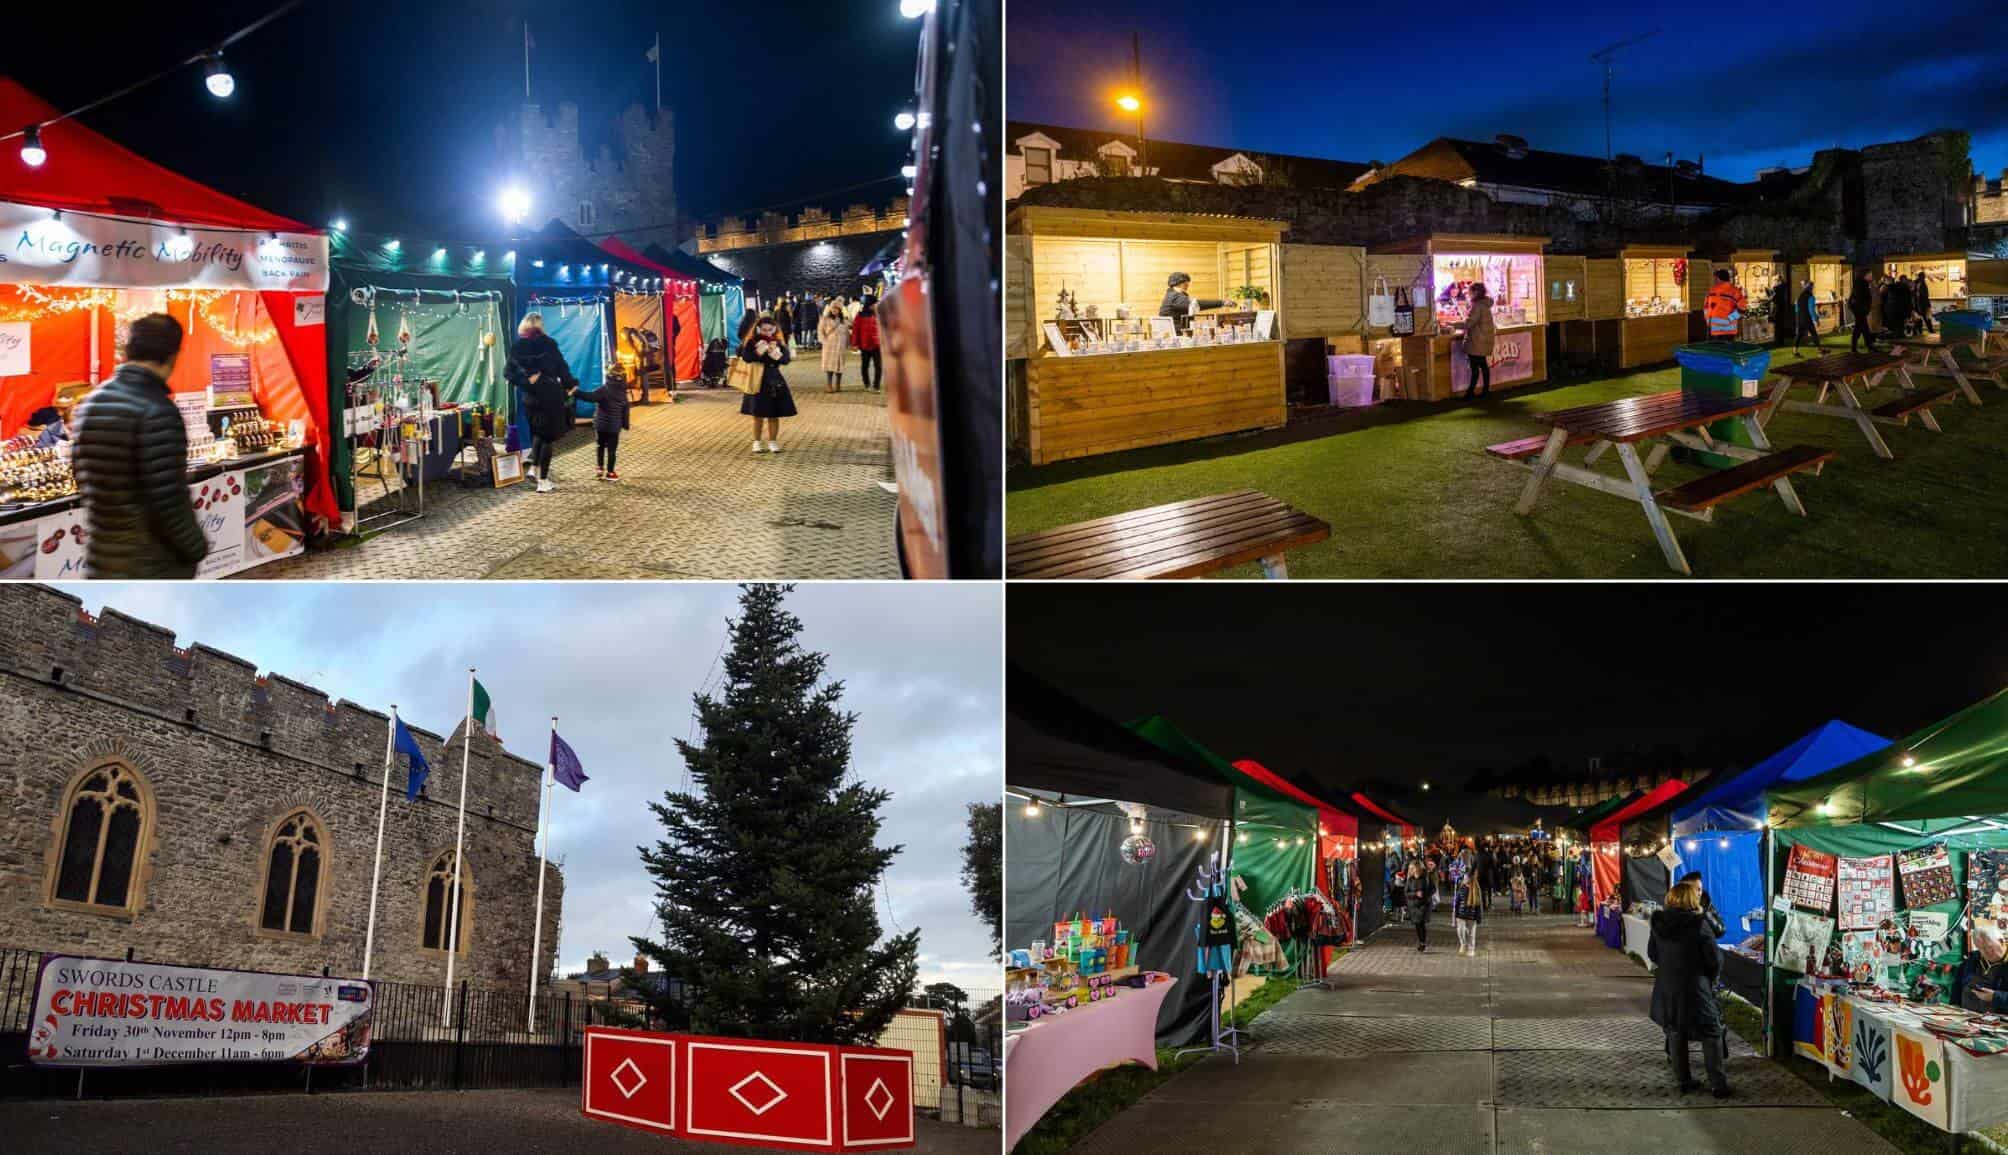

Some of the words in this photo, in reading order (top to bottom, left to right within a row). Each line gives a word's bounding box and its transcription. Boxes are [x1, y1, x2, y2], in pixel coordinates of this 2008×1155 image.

[16, 230, 147, 263] Magnetic
[153, 241, 243, 271] Mobility
[57, 968, 144, 988] SWORDS
[150, 974, 218, 993] CASTLE
[50, 989, 226, 1022] CHRISTMAS
[231, 1000, 333, 1025] MARKET
[72, 1023, 120, 1040] Friday
[123, 1024, 149, 1038] 30th
[152, 1026, 217, 1039] November
[221, 1029, 251, 1042] 12pm
[262, 1030, 285, 1043] 8pm
[63, 1046, 130, 1061] Saturday
[136, 1047, 149, 1059] 1st
[153, 1047, 217, 1059] December
[221, 1048, 250, 1059] 11am
[261, 1048, 285, 1059] 6pm
